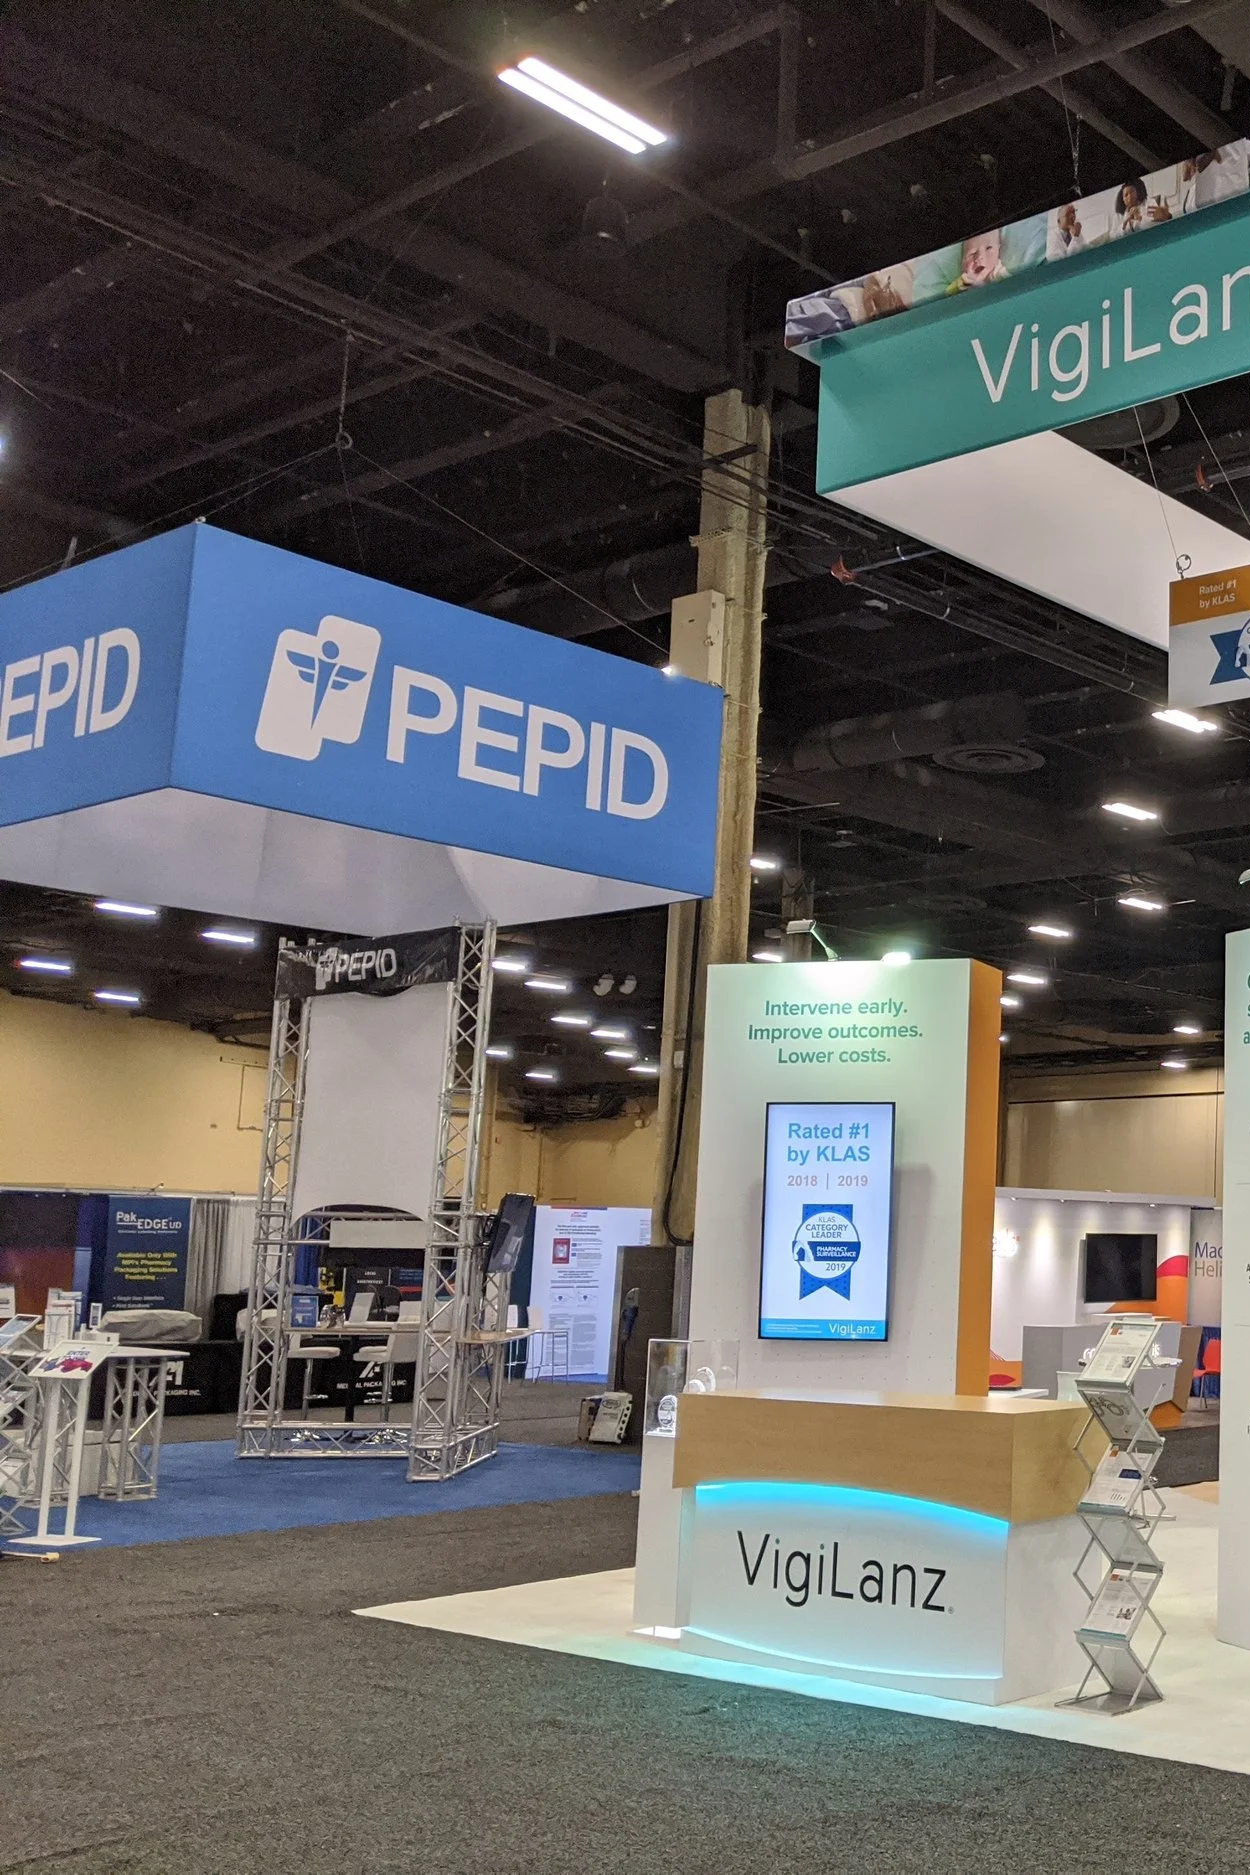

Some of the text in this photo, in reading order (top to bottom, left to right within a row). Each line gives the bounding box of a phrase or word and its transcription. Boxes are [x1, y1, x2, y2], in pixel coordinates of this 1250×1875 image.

[1199, 579, 1237, 595] Rated #1
[1199, 593, 1236, 608] by KLAS
[0, 627, 140, 758] EPID
[386, 665, 669, 820] PEPID
[335, 948, 397, 983] PEPID
[765, 998, 908, 1018] Intervene early.
[748, 1022, 923, 1044] Improve outcomes.
[778, 1048, 891, 1064] Lower costs.
[788, 1122, 870, 1139] Rated #1
[787, 1146, 870, 1166] by KLAS
[787, 1175, 868, 1187] 2018 2019
[805, 1224, 848, 1232] CATEGORY
[811, 1231, 842, 1239] LEADER
[825, 1263, 846, 1272] 2019
[829, 1323, 876, 1336] VigiLanz
